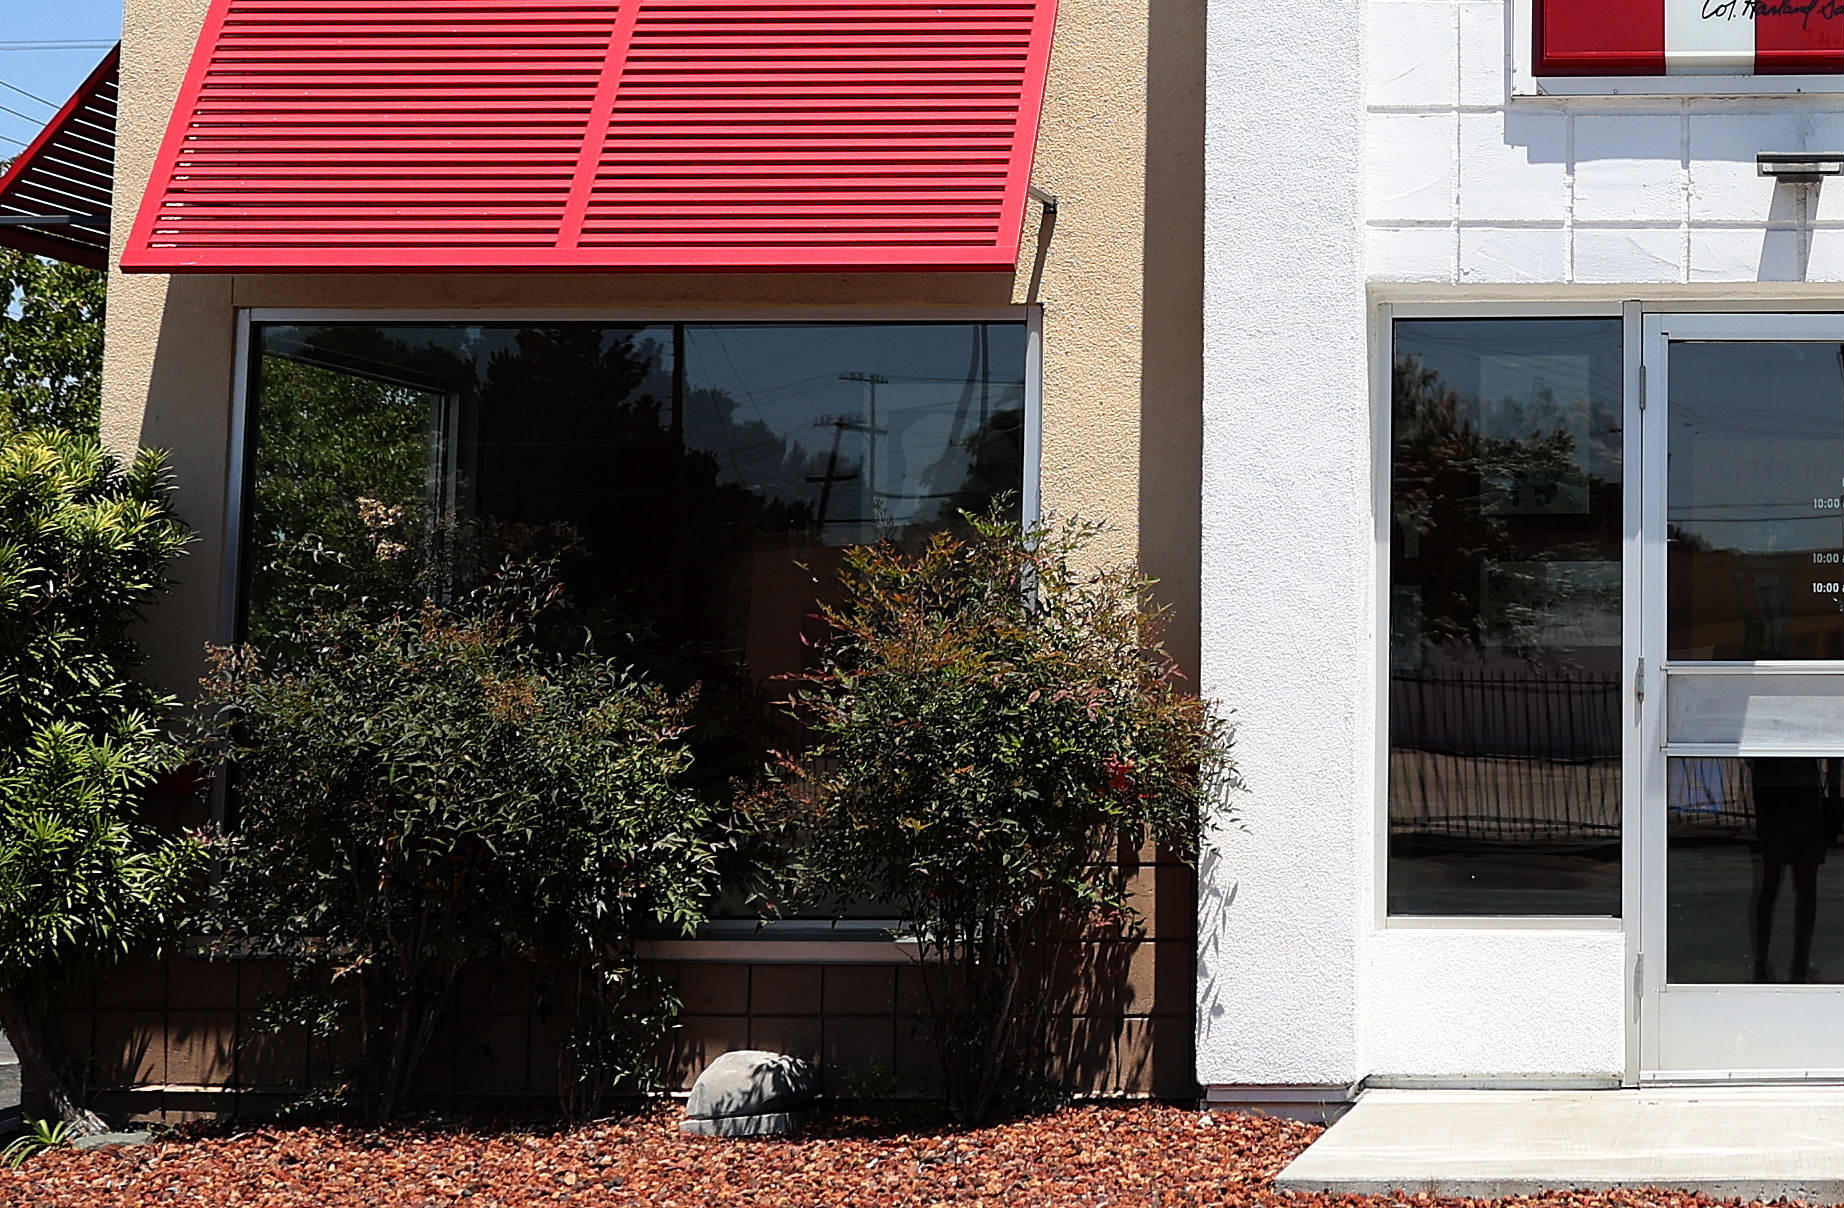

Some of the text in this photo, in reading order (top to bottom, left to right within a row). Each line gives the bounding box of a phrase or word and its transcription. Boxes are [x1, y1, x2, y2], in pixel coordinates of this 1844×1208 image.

[1813, 498, 1840, 509] 10:00
[1812, 553, 1839, 564] 10:00
[1812, 582, 1839, 593] 10:00
